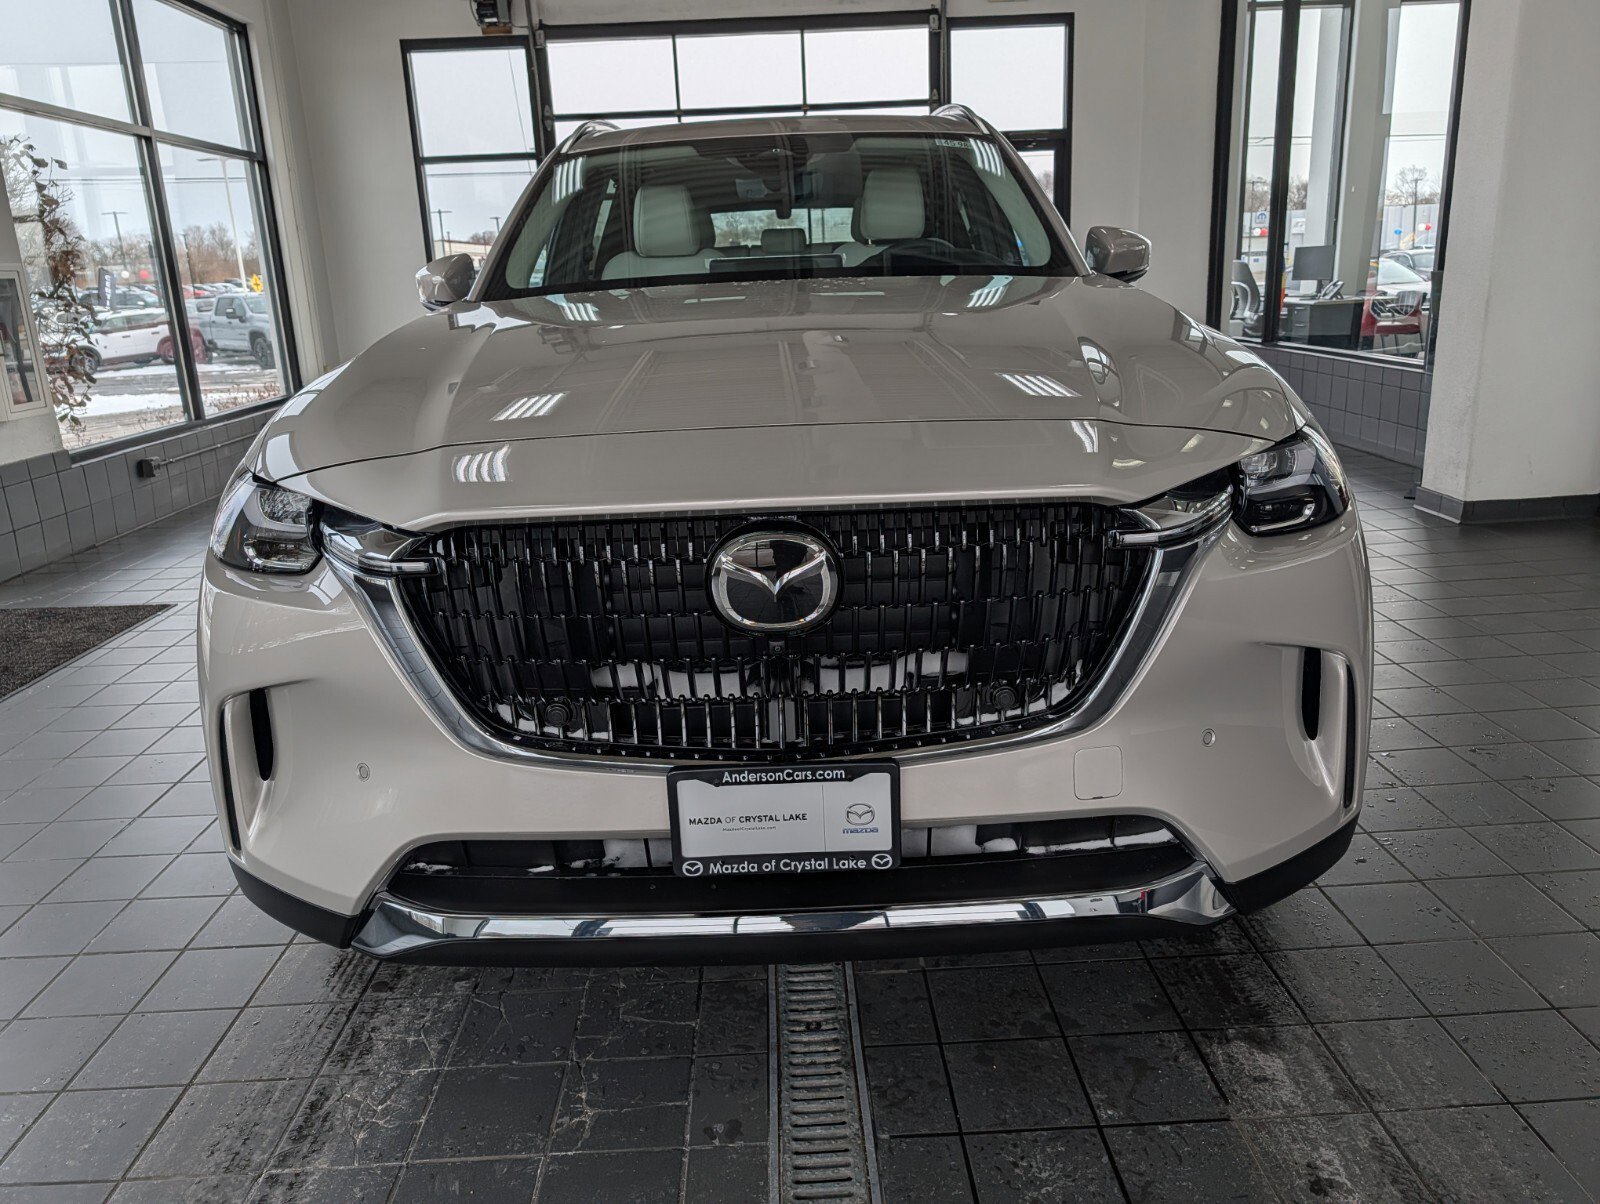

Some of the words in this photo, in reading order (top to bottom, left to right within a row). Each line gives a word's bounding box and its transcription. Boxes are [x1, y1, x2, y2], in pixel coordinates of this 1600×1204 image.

[722, 769, 845, 783] AndersonCars.com
[688, 817, 722, 825] MAZDA
[725, 816, 736, 824] OF
[738, 814, 780, 823] CRYSTAL
[782, 813, 807, 821] LAKE
[709, 860, 758, 874] Mazda
[762, 859, 776, 871] of
[779, 858, 828, 873] Crystal
[833, 857, 867, 869] Lake
